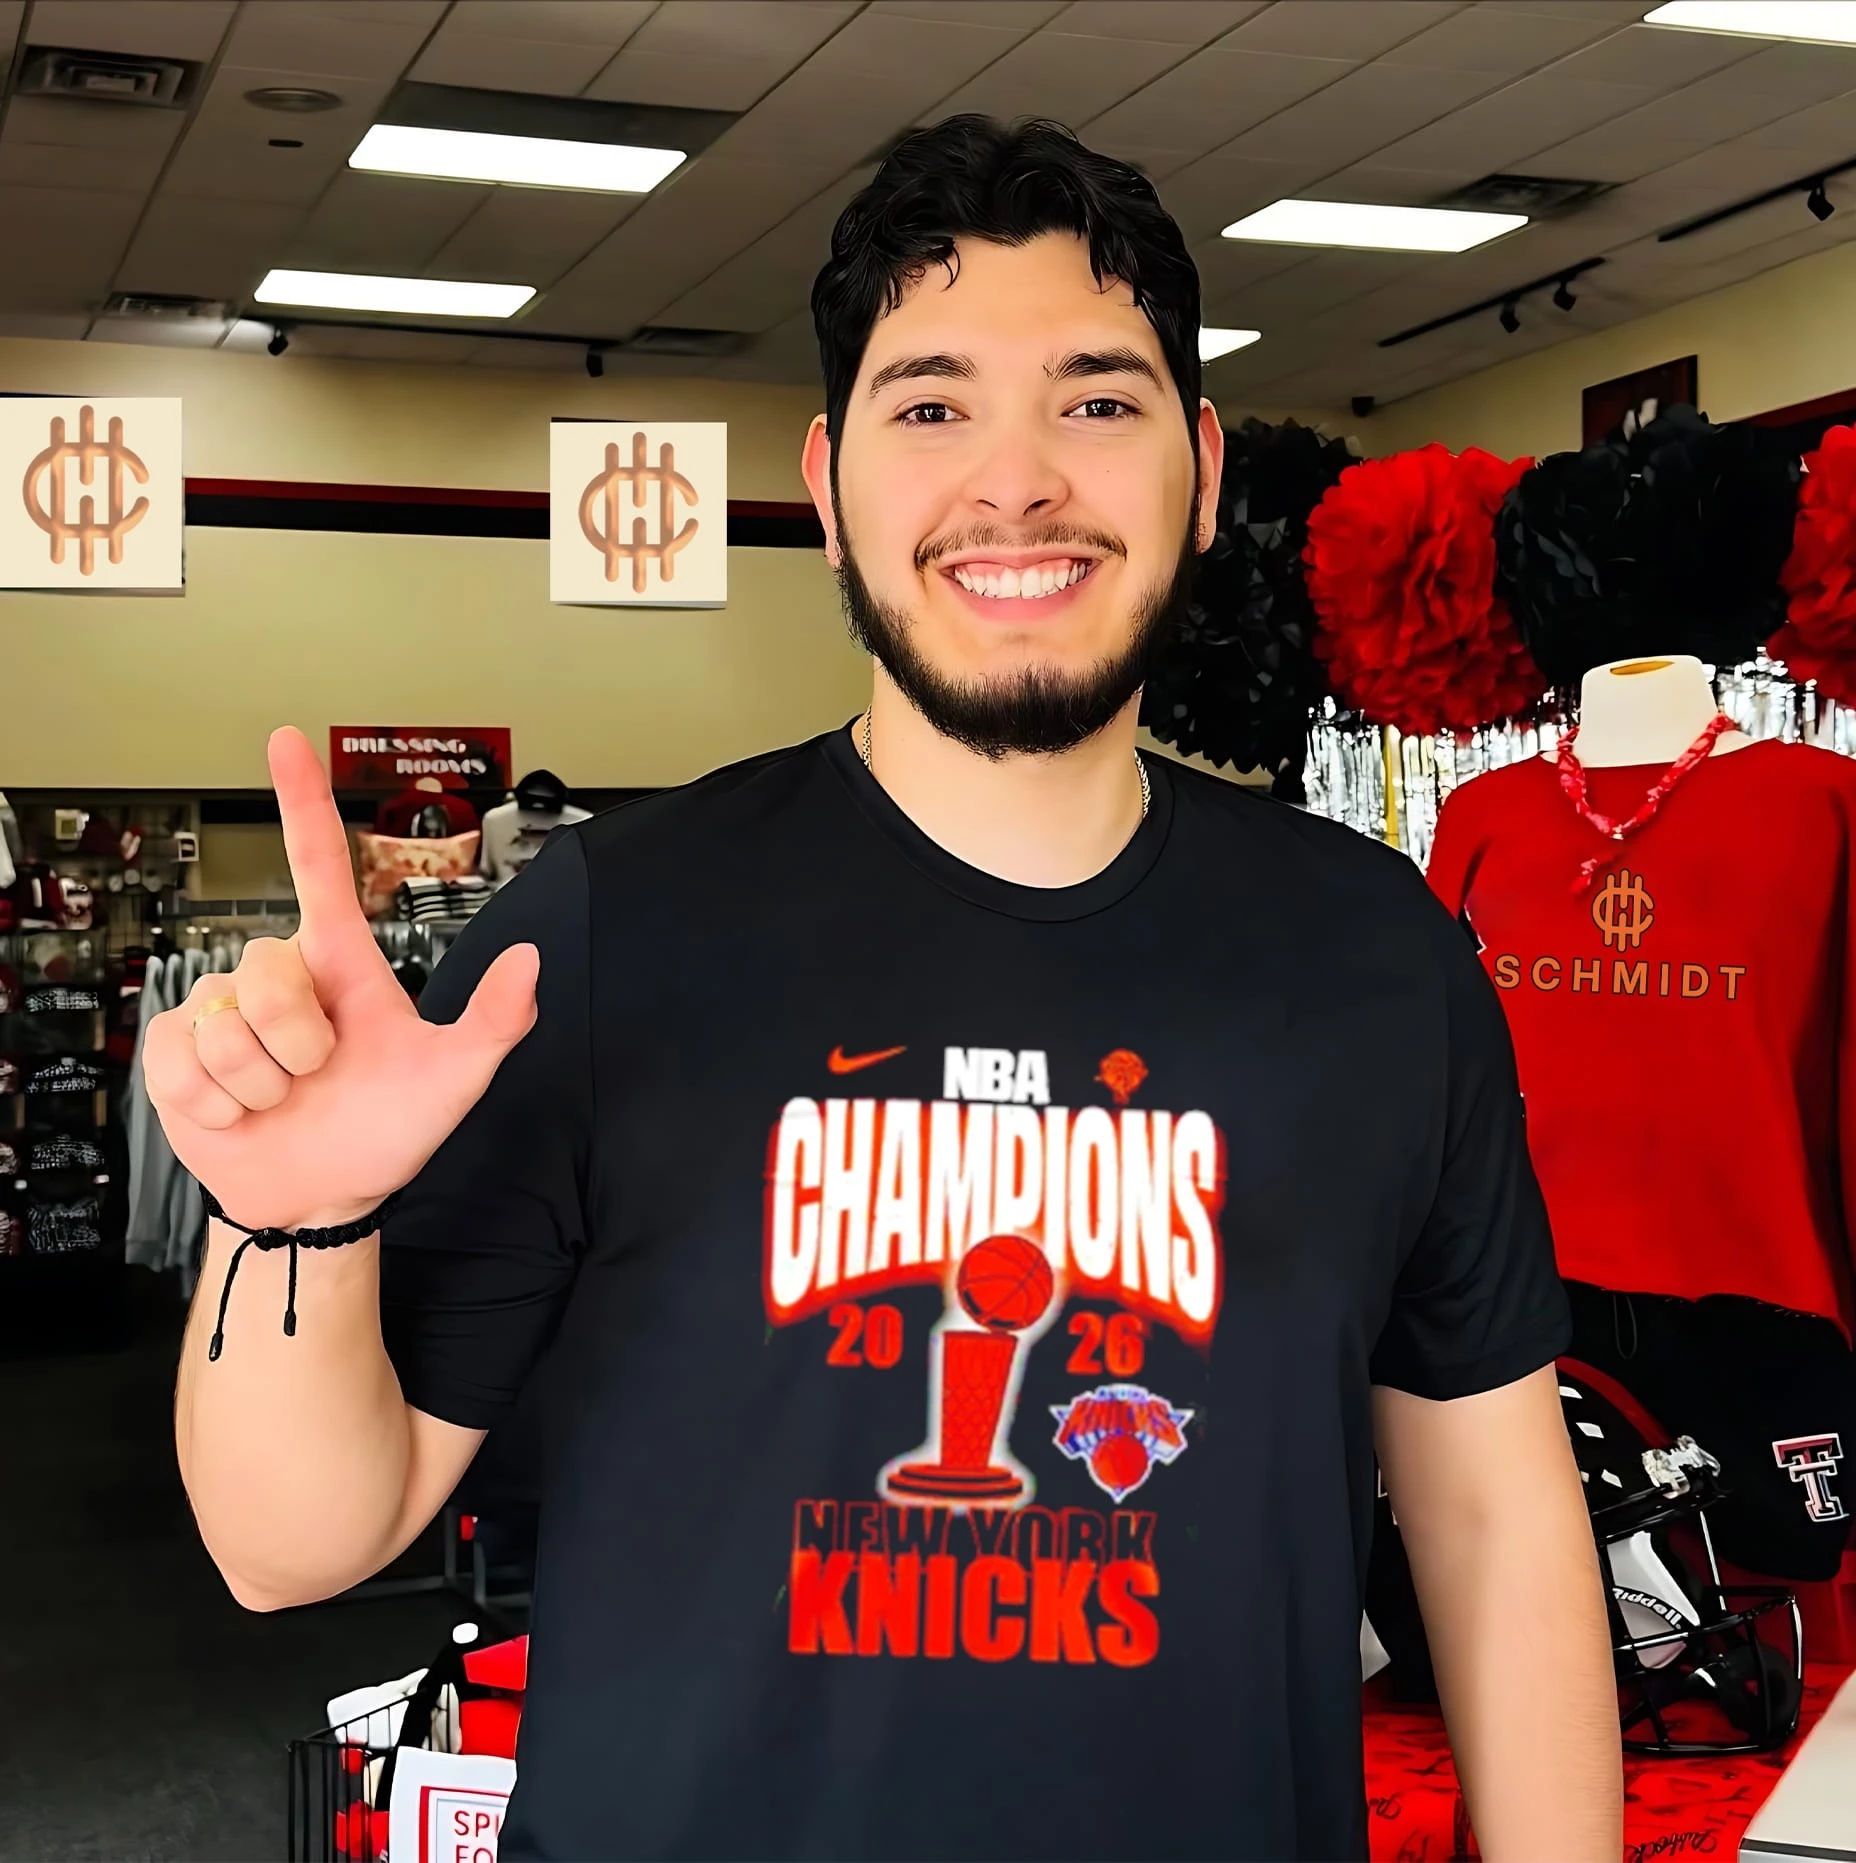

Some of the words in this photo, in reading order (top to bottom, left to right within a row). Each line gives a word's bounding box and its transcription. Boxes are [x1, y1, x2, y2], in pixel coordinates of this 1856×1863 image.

[1494, 954, 1747, 1000] SCHMIDT
[943, 1046, 1051, 1105] NBA
[770, 1096, 1218, 1323] CHAMPIONS
[826, 1303, 904, 1370] 20
[1066, 1311, 1146, 1378] 26
[794, 1500, 949, 1562] NEW
[965, 1505, 1159, 1568] YORK
[788, 1551, 1161, 1668] KNICKS
